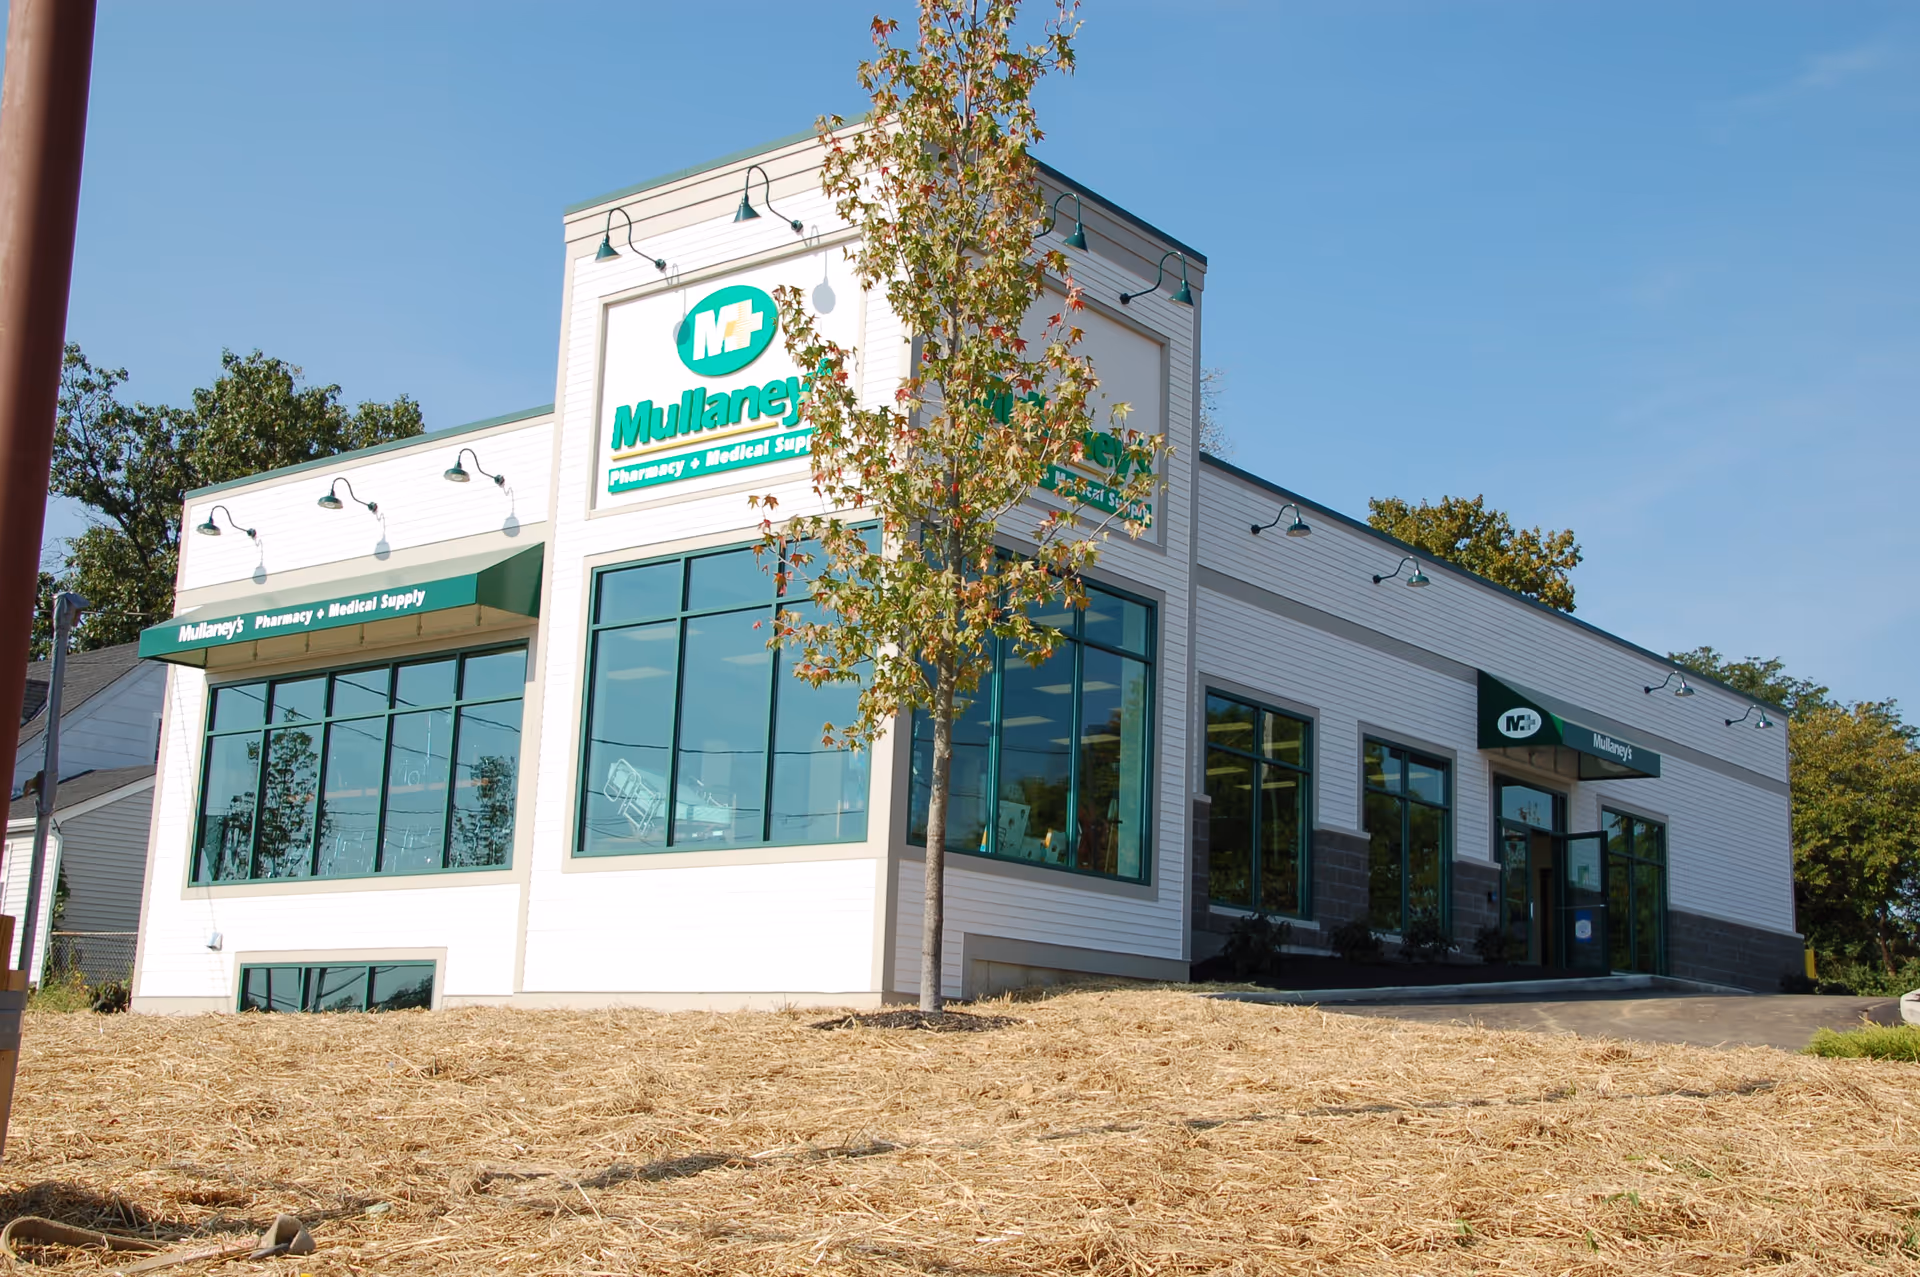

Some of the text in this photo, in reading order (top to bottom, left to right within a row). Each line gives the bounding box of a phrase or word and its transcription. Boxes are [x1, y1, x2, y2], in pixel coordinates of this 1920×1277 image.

[611, 362, 832, 449] Mullaney
[609, 459, 685, 487] Pharmacy
[705, 440, 769, 467] Medical
[775, 434, 815, 454] Supp
[178, 616, 244, 642] Mullaney's
[255, 610, 313, 629] Pharmacy
[328, 596, 377, 618] Medical
[381, 589, 426, 610] Supply
[1593, 732, 1632, 762] Mullaney's
